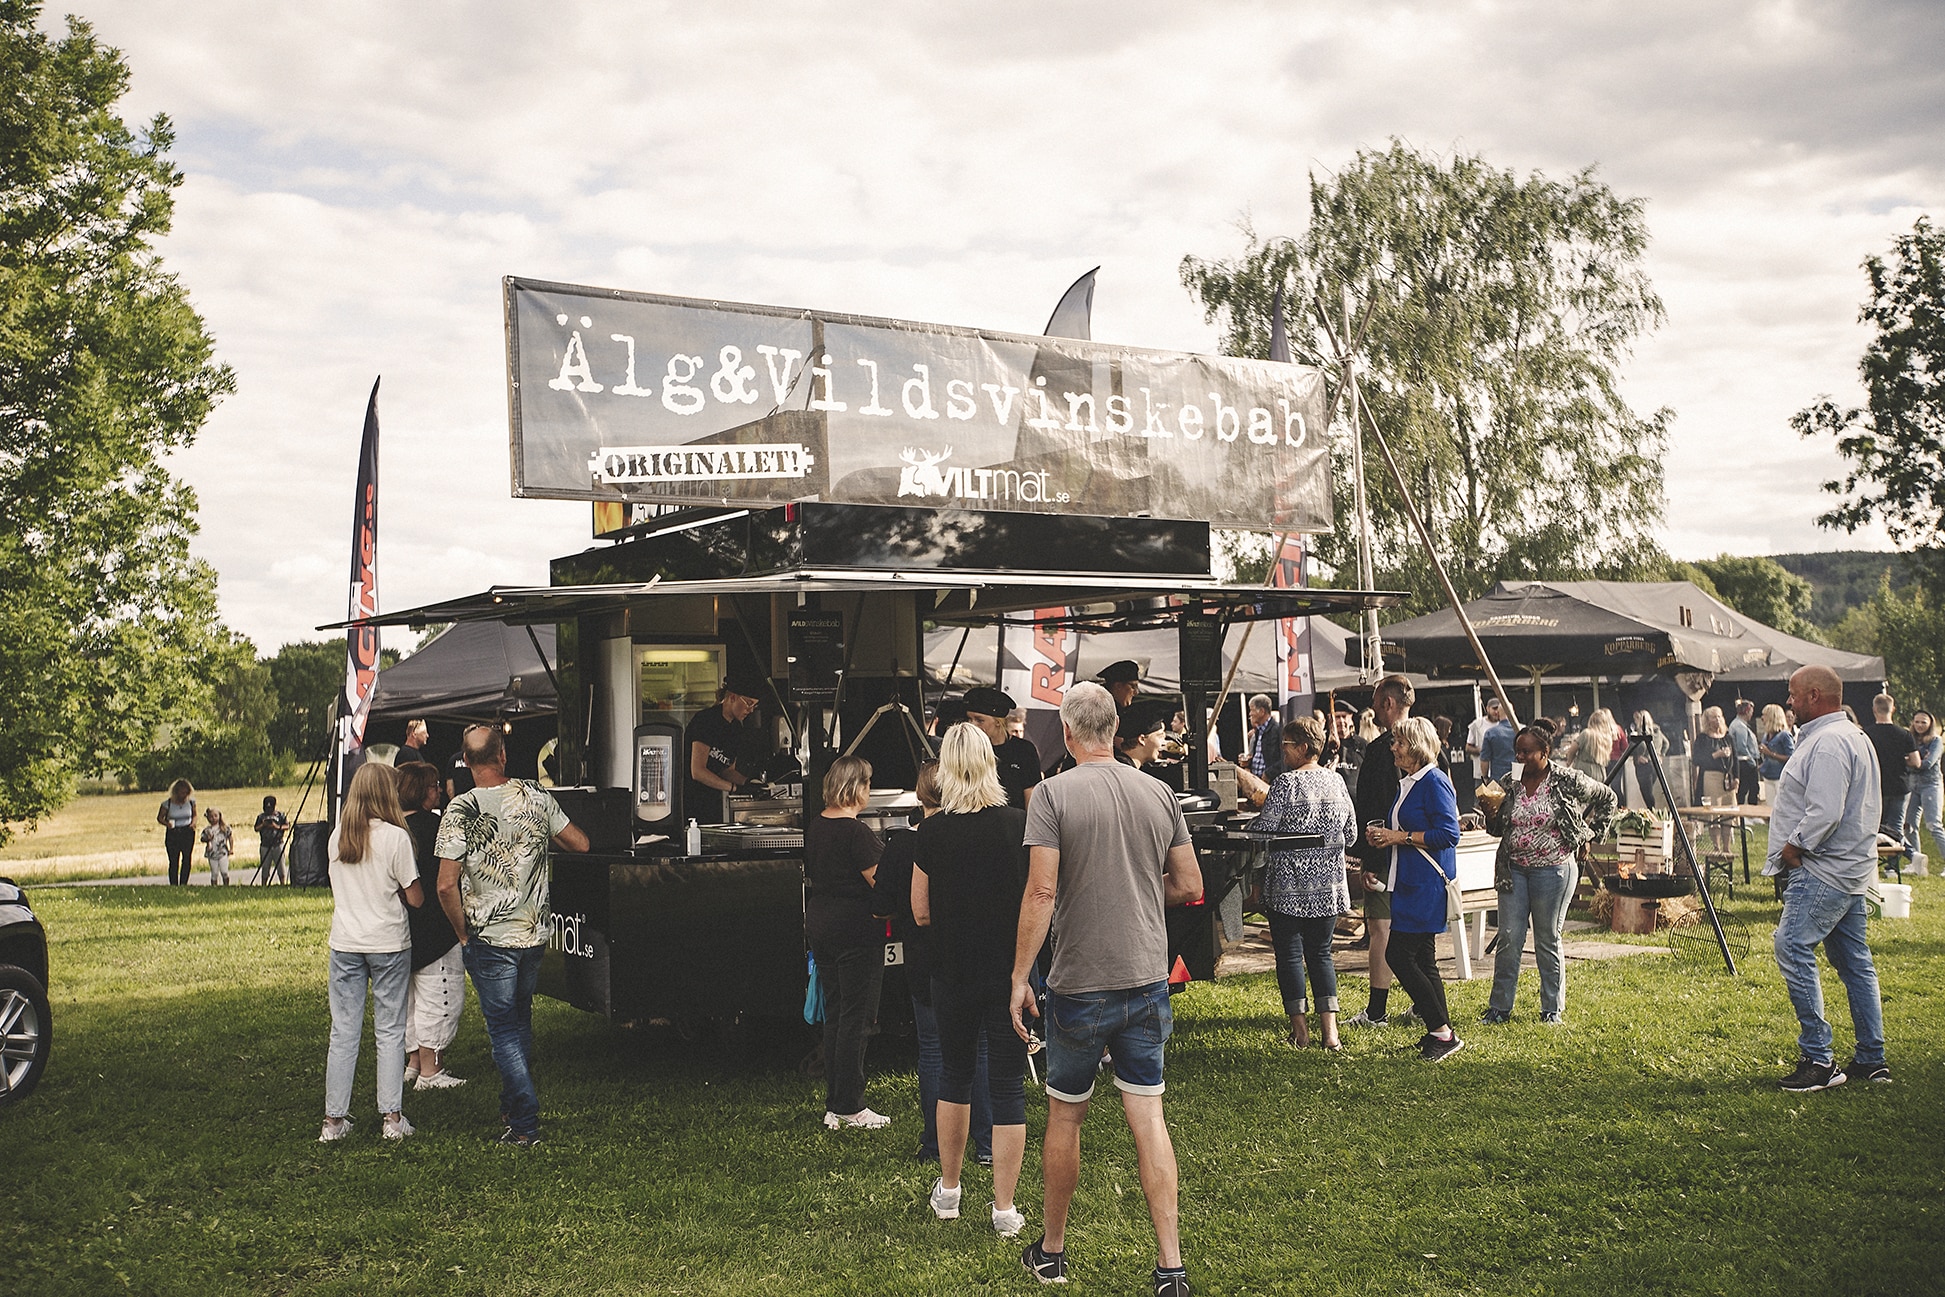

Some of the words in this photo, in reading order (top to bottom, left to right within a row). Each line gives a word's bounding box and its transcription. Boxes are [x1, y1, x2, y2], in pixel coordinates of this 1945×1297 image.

[548, 313, 1307, 448] Älg&Vildsvinskebab
[604, 451, 799, 476] ORIGINALET!
[886, 945, 896, 963] 3
